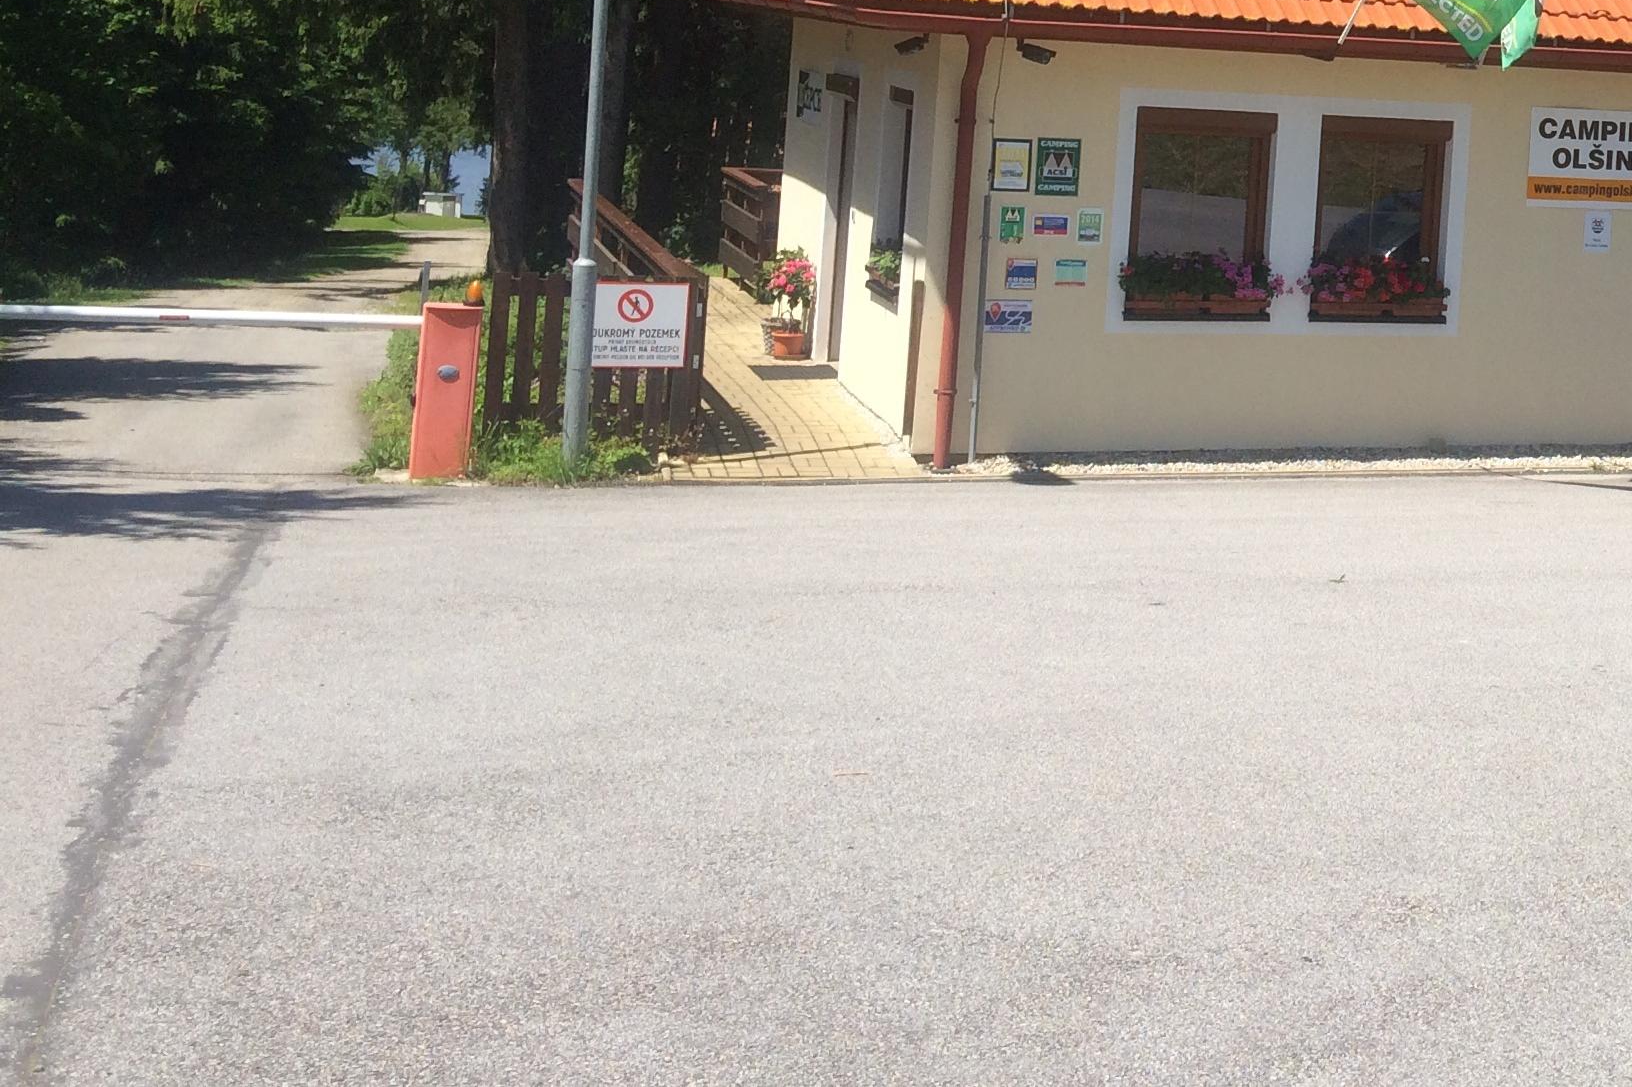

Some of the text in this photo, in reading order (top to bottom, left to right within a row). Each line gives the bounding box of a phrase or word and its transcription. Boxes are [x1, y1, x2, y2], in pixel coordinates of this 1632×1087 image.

[1040, 140, 1079, 148] CAMPING
[1038, 184, 1076, 192] CAMPING
[640, 328, 681, 338] POZEMEK
[594, 345, 608, 353] TUP
[639, 345, 648, 353] NA
